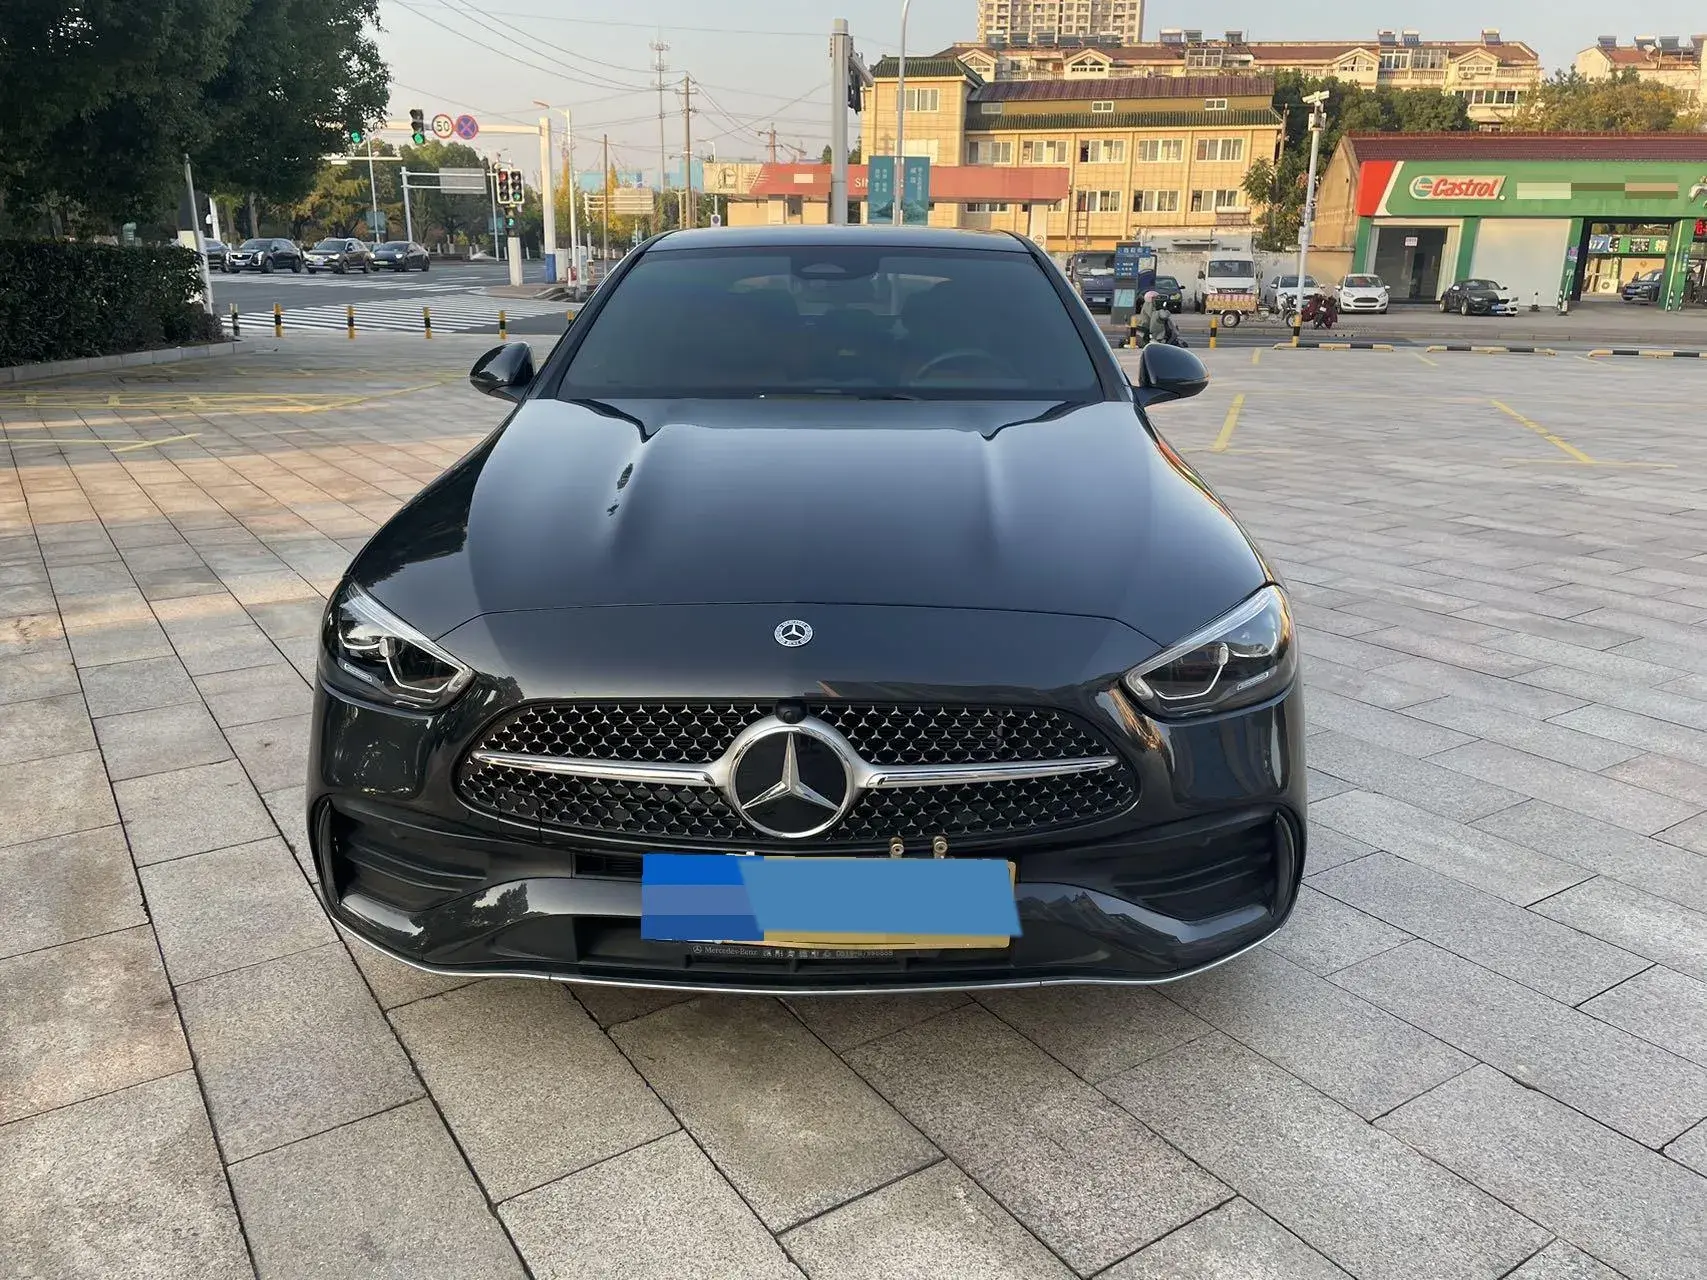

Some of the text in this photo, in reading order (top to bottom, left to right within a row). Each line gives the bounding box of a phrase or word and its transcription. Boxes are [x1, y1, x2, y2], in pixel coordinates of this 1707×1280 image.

[436, 120, 449, 132] 50
[1431, 178, 1499, 197] Castrol
[704, 946, 758, 956] Mercedes-Benz
